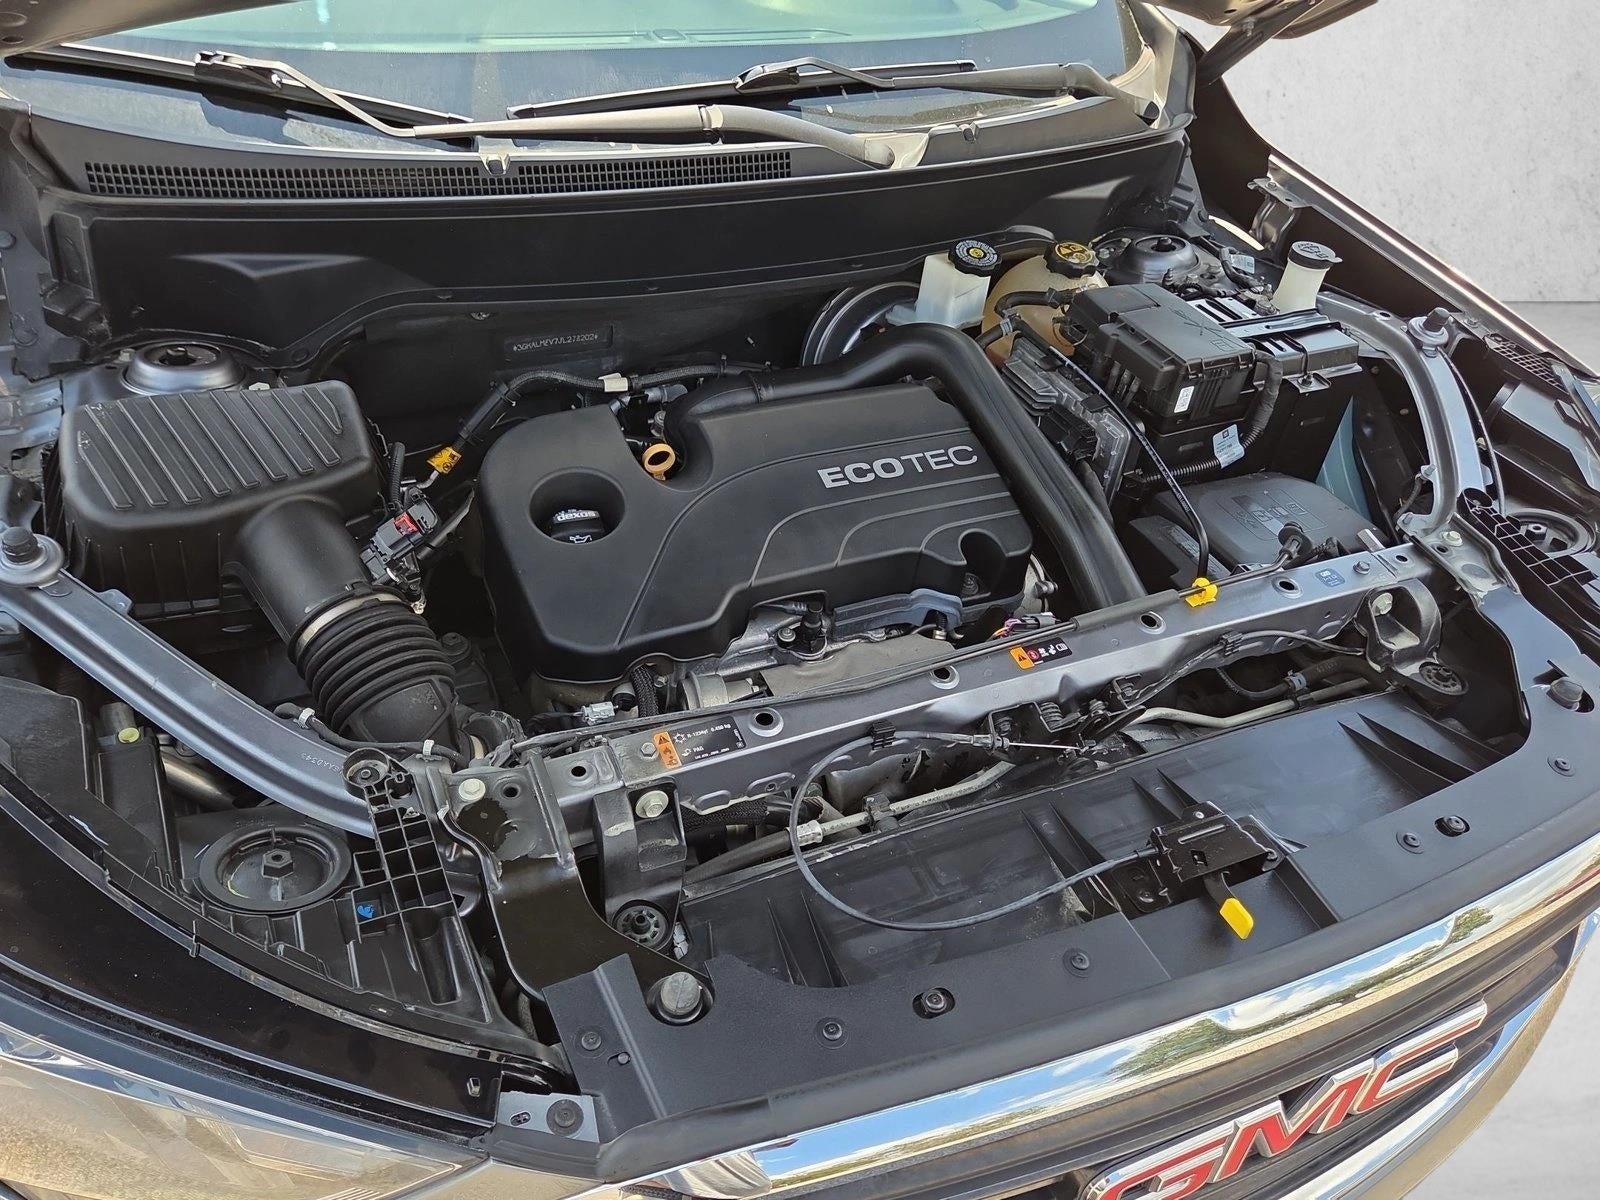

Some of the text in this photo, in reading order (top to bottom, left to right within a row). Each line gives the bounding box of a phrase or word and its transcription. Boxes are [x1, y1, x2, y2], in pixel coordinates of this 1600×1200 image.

[817, 445, 978, 489] ECOTEC
[557, 510, 596, 521] dexos
[1083, 1000, 1488, 1200] GMC
